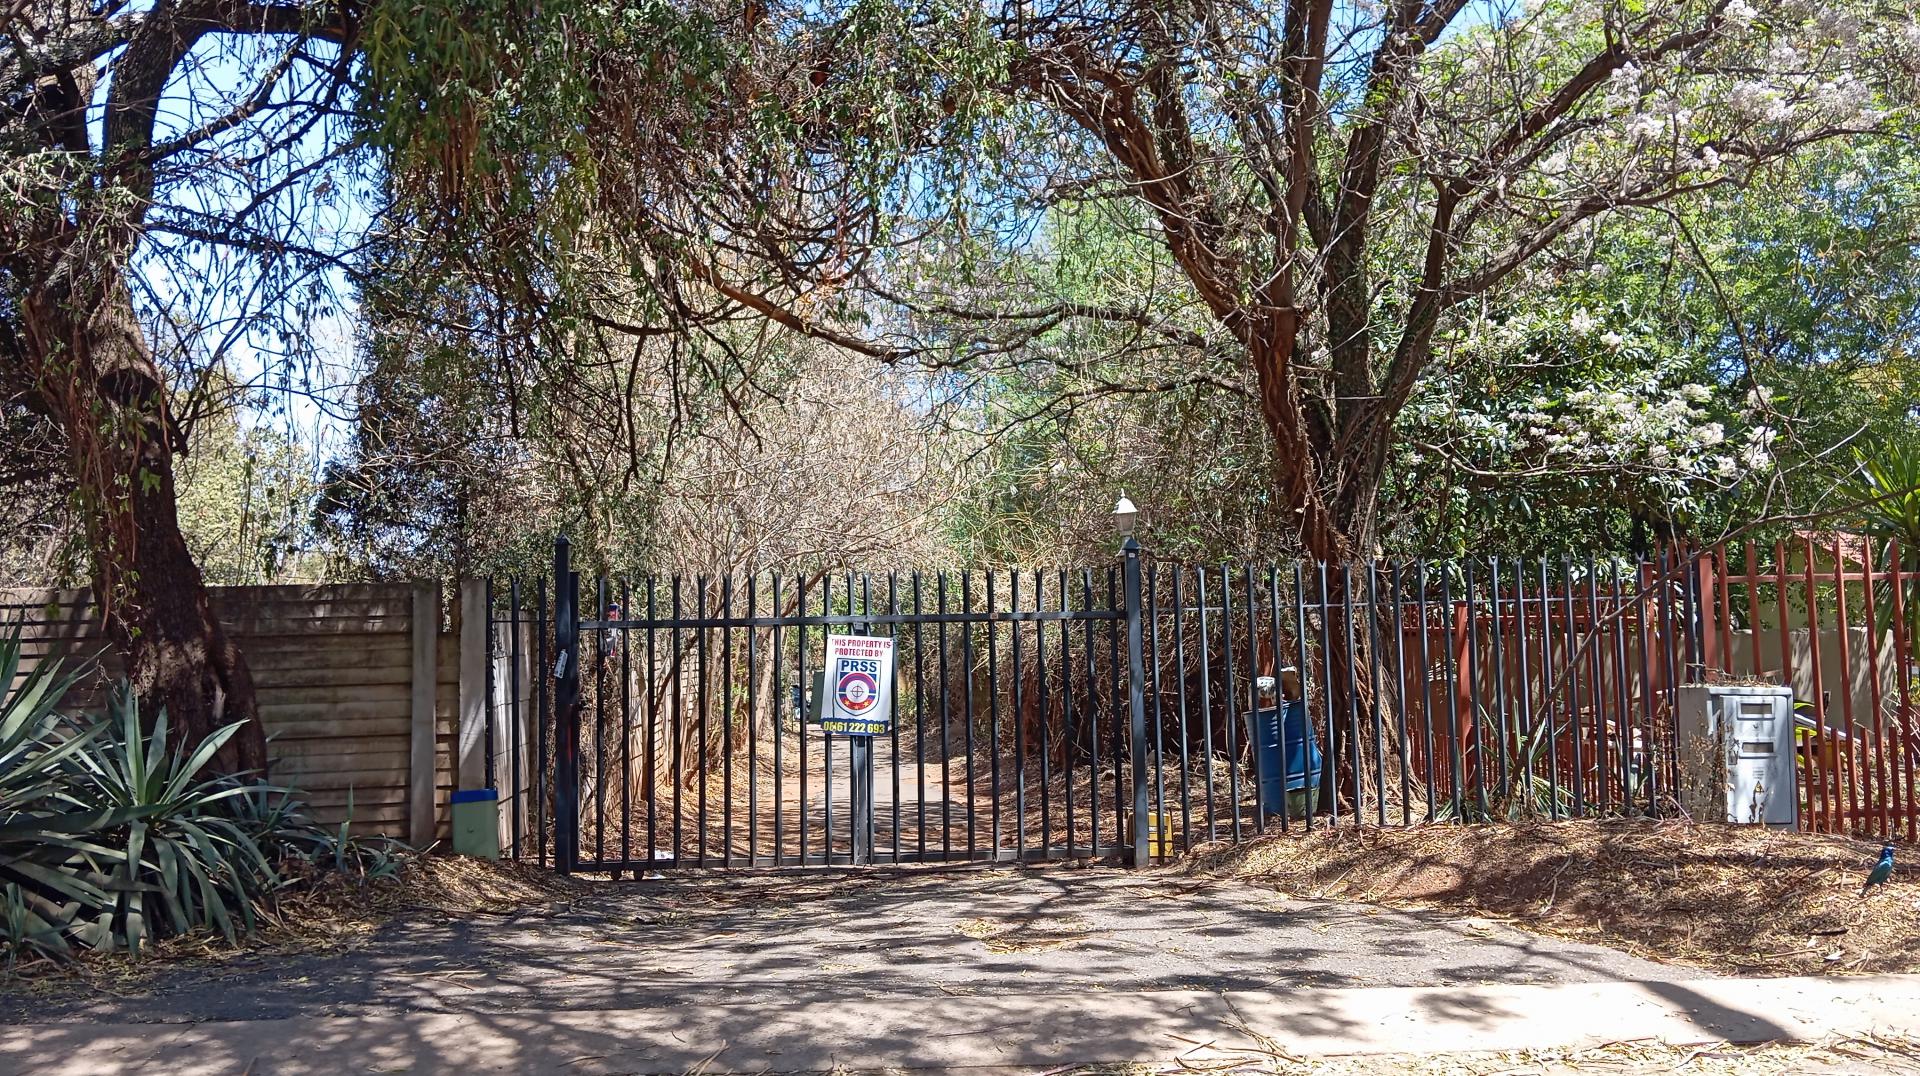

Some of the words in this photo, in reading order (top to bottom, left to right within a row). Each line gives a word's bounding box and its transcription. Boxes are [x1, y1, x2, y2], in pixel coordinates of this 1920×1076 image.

[848, 639, 882, 649] PROPERTY
[884, 641, 892, 649] IS
[835, 648, 873, 657] PROTECTED
[875, 650, 884, 658] BY
[841, 660, 877, 673] PRSS
[848, 722, 866, 733] 222
[867, 723, 885, 734] 693
